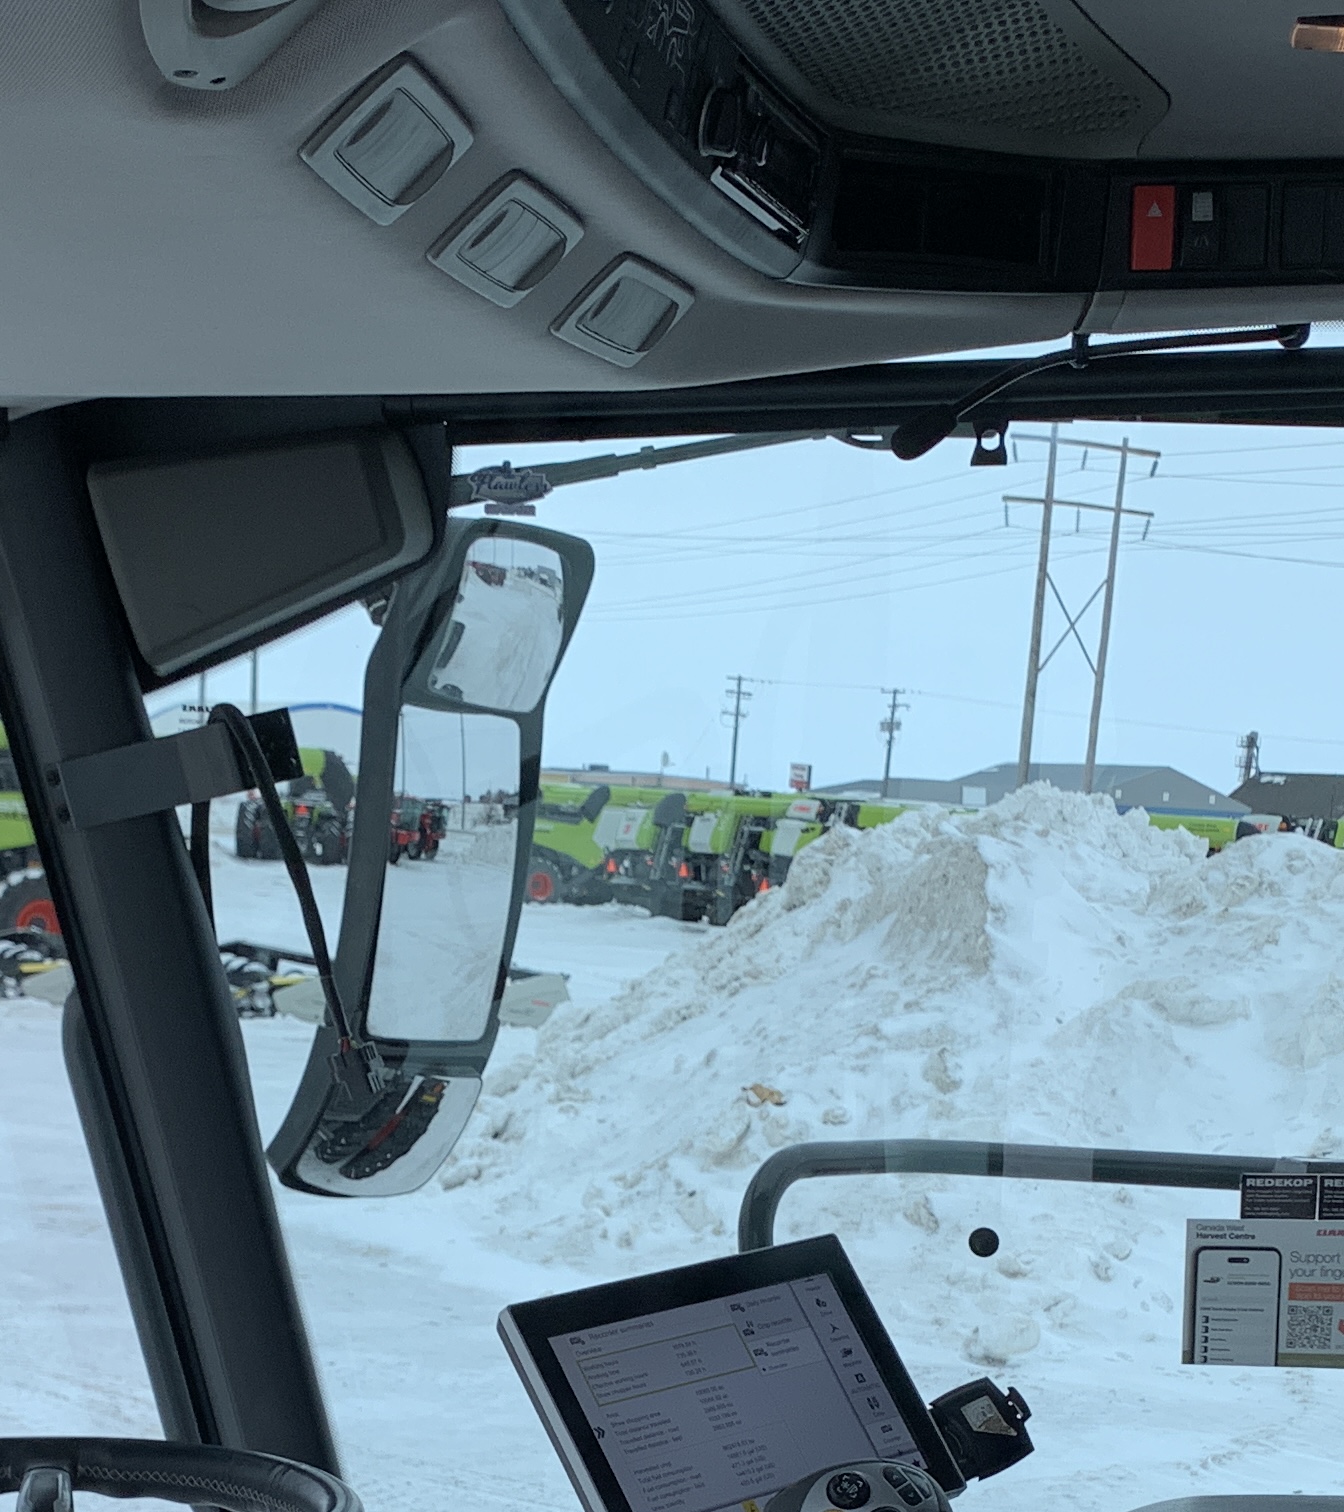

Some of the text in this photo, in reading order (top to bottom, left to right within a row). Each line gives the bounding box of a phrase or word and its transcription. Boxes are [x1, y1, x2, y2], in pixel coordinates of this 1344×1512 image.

[1246, 1177, 1313, 1188] REDEKOP
[1195, 1223, 1245, 1232] Canada West
[1195, 1232, 1256, 1240] Harvest Centre
[1290, 1250, 1341, 1265] Support
[1289, 1268, 1316, 1279] your
